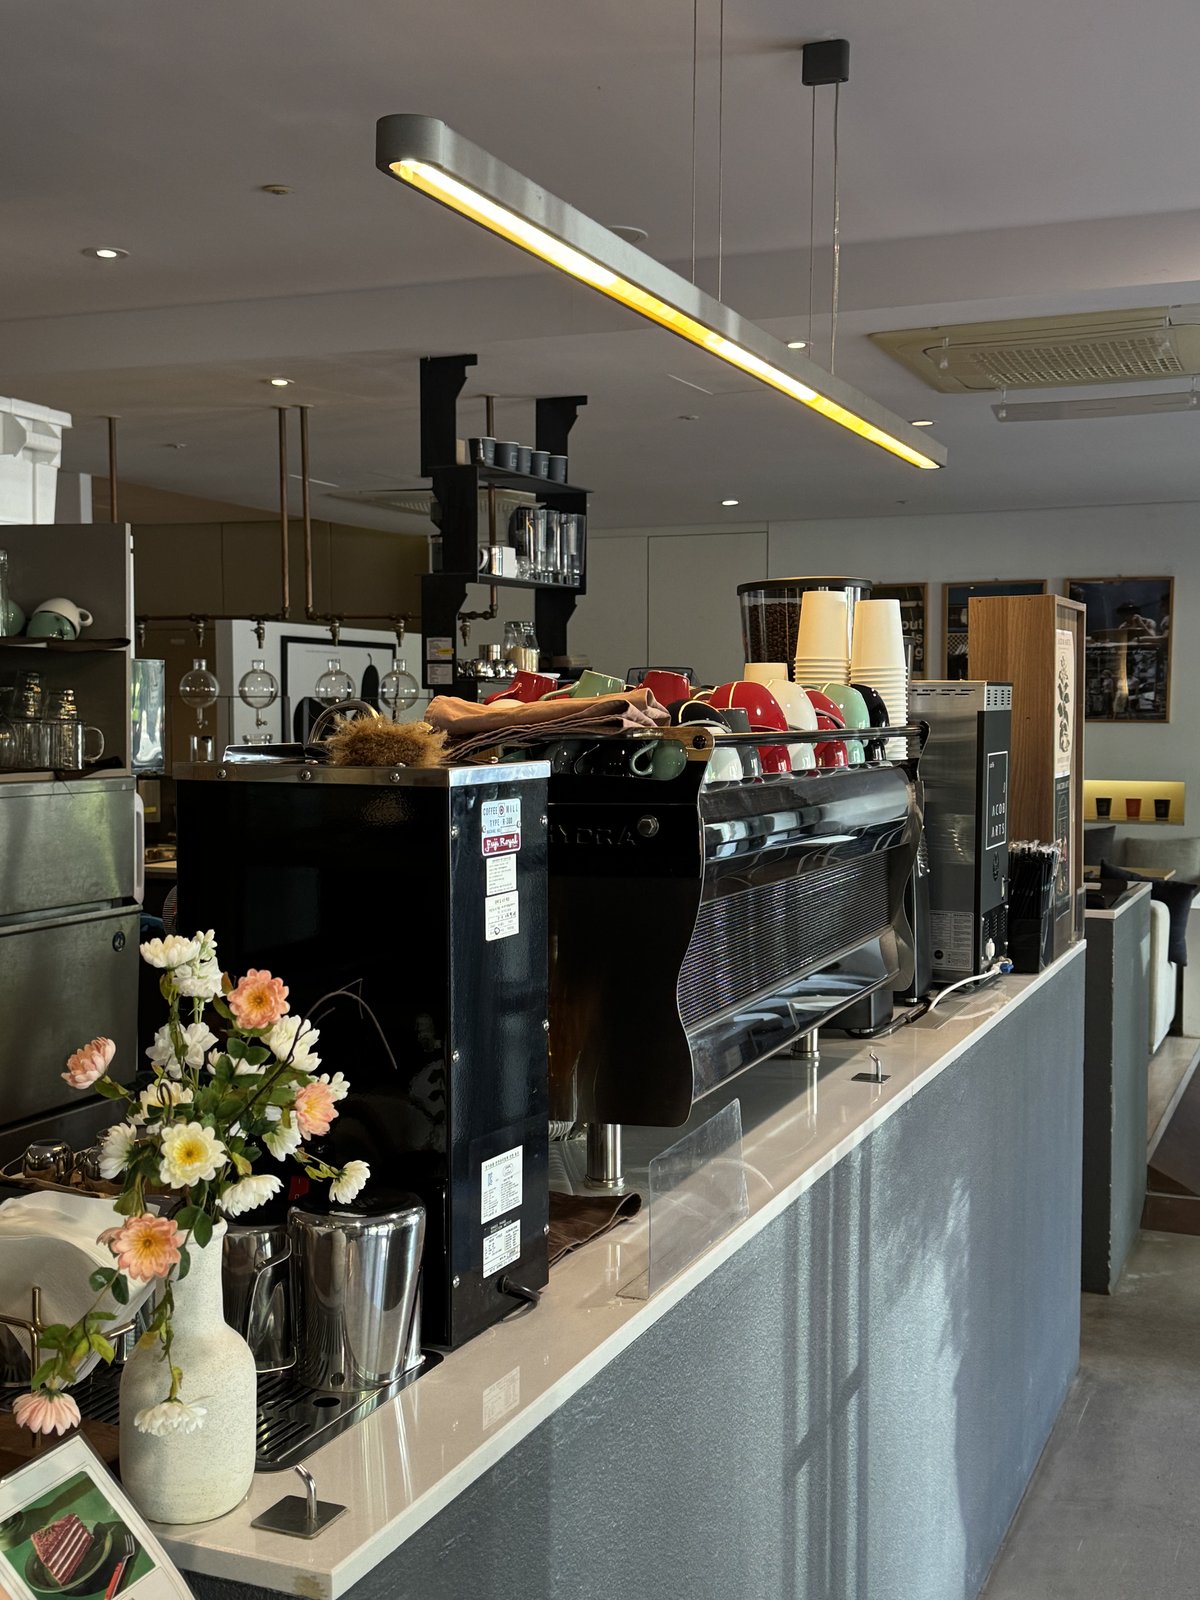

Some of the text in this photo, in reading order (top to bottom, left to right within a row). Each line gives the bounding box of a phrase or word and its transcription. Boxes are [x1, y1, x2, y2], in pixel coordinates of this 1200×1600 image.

[902, 619, 923, 631] out
[483, 804, 519, 817] COFFEE MILL
[991, 802, 1006, 817] ACOB
[489, 818, 500, 828] TYPE
[990, 823, 1005, 838] ARTS
[485, 834, 519, 853] Fuji Royal
